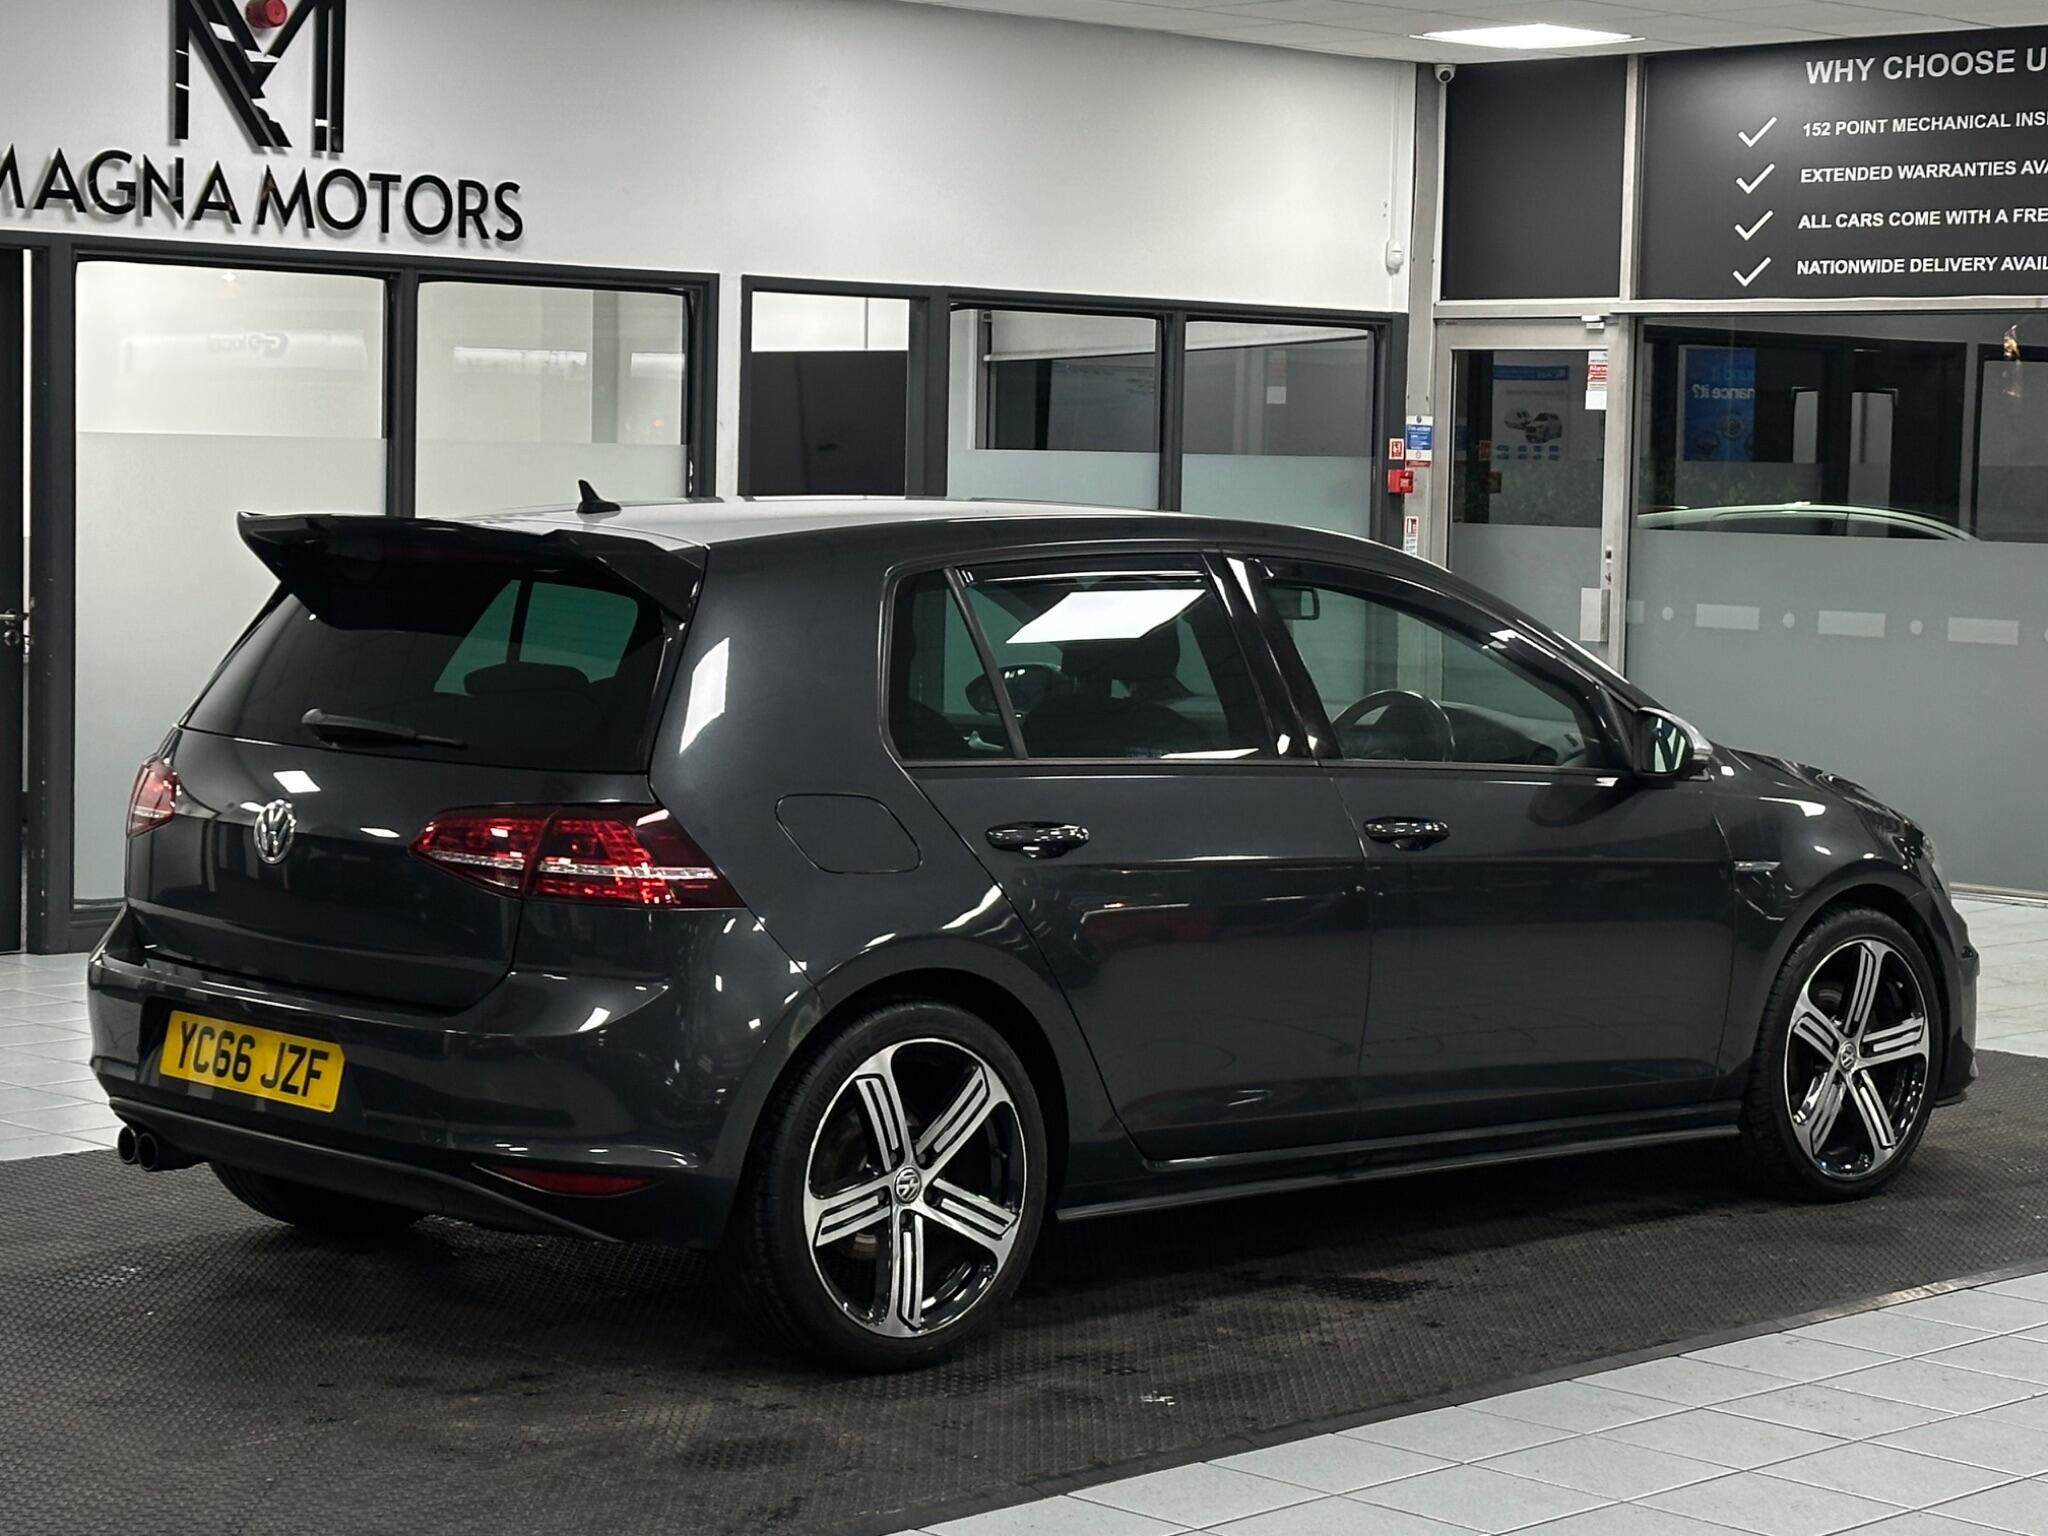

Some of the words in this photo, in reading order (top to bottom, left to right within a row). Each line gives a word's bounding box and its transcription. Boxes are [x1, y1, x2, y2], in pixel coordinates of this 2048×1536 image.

[1805, 57, 1876, 84] WHY
[1883, 49, 2016, 80] CHOOSE
[1802, 121, 1831, 137] 152
[1835, 118, 1888, 135] POINT
[1892, 113, 2012, 132] MECHANICAL
[2015, 111, 2048, 127] INS
[1800, 165, 1893, 183] EXTENDED
[1898, 160, 2017, 179] WARRANTIES
[257, 164, 523, 242] MOTORS
[1798, 214, 1832, 229] ALL
[1836, 212, 1884, 227] CARS
[1889, 210, 1941, 226] COME
[1945, 209, 1991, 224] WITH
[1995, 208, 2009, 223] A
[2013, 207, 2048, 223] FRE
[1797, 258, 1905, 275] NATIONWIDE
[1909, 256, 1999, 272] DELIVERY
[178, 1020, 256, 1083] YC66
[260, 1042, 329, 1097] JZF
